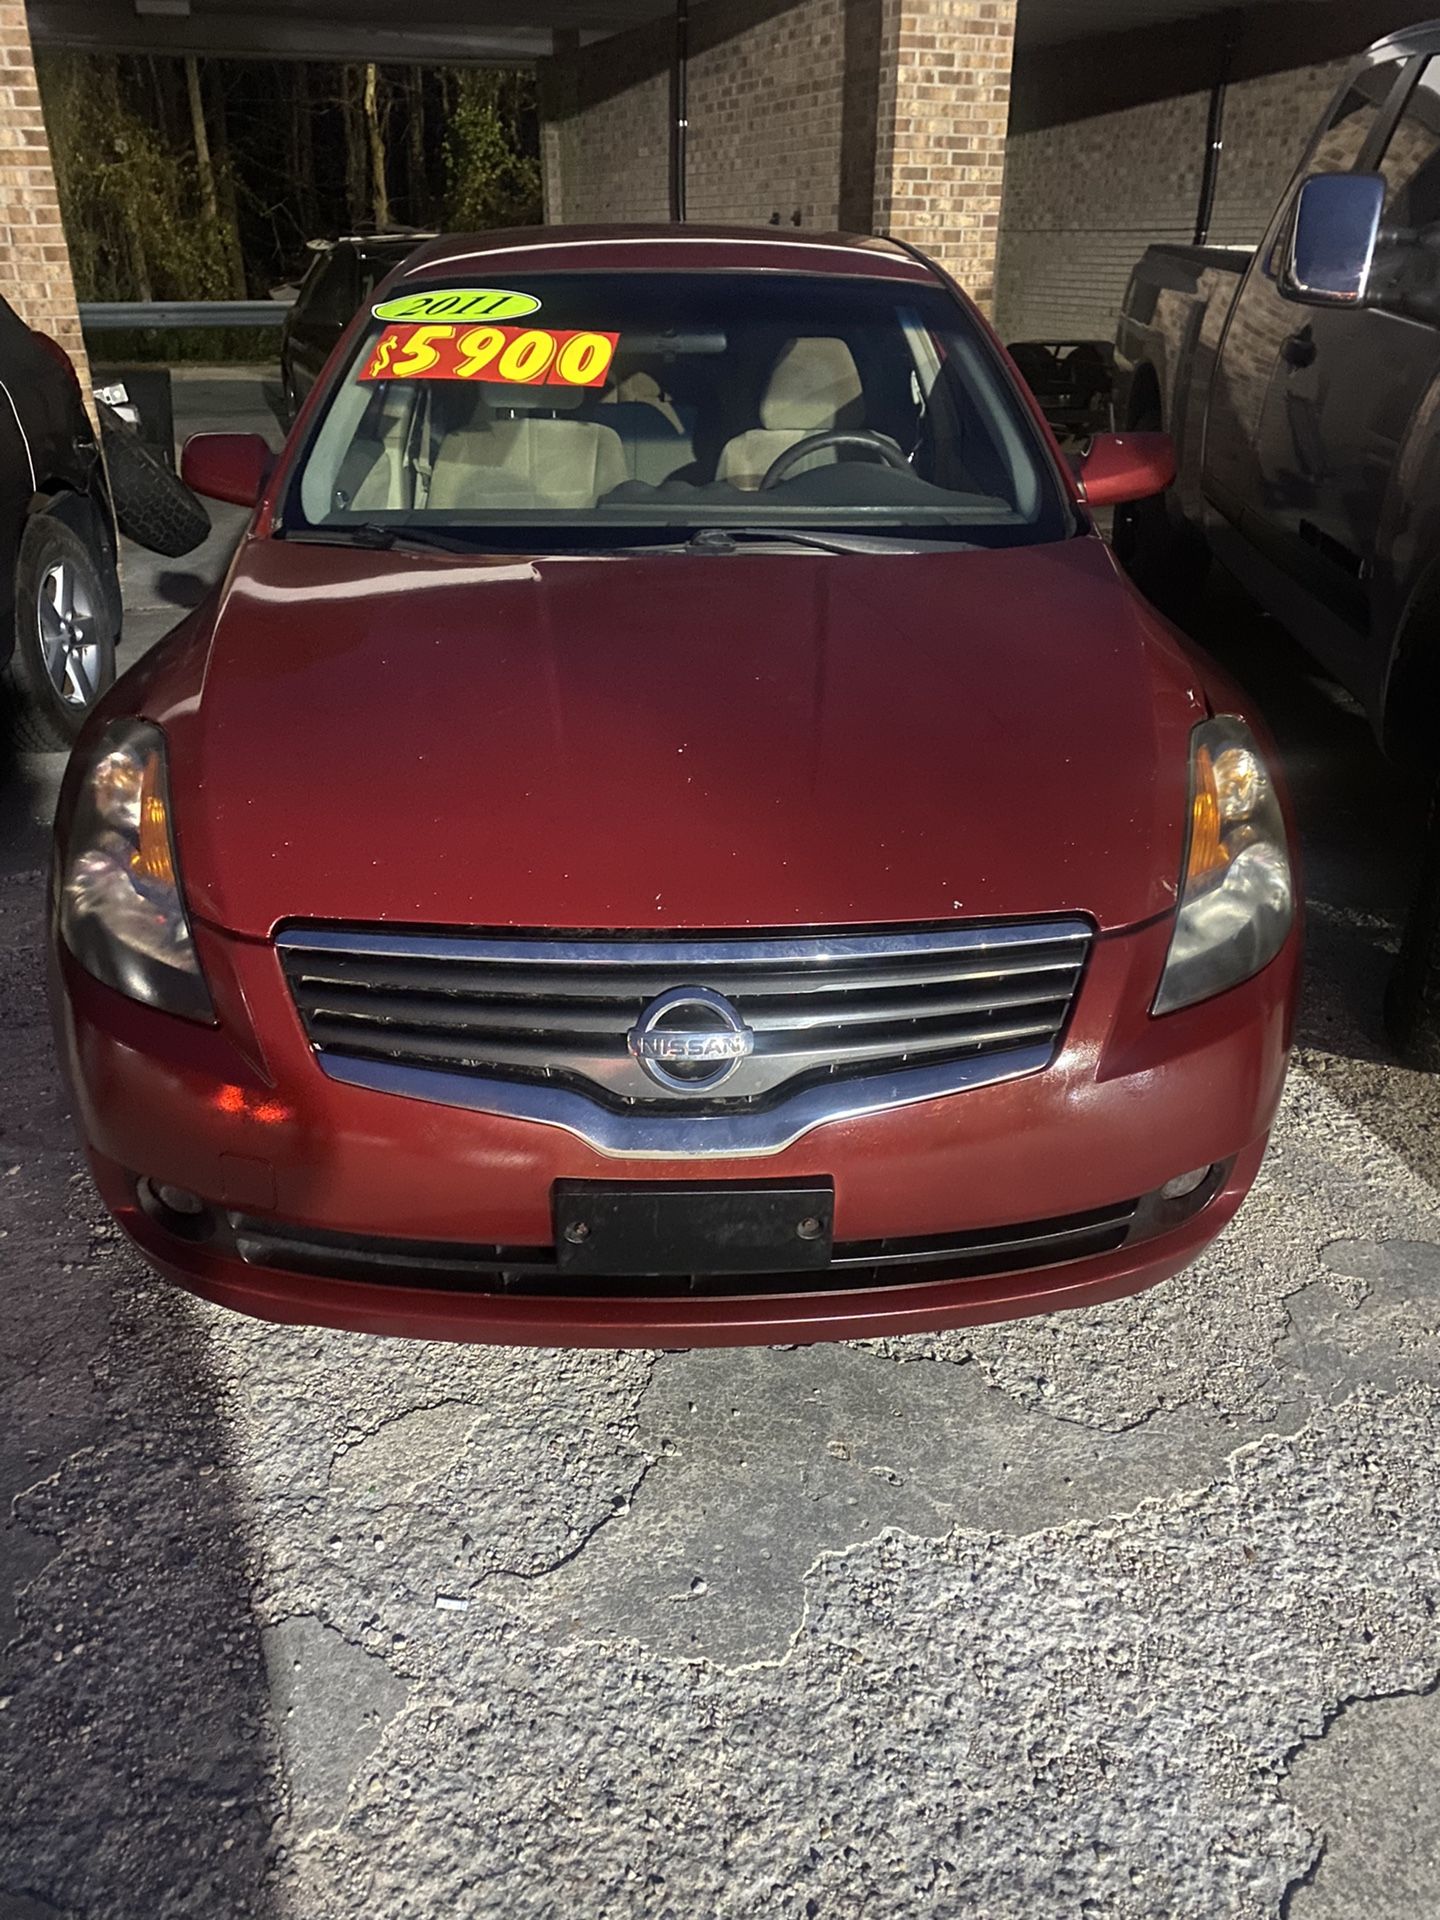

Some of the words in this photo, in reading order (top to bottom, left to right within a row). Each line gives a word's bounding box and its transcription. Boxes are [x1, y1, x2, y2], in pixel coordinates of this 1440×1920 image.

[394, 296, 513, 317] 2011
[369, 325, 612, 384] $5900
[639, 1037, 745, 1057] NISSAN
